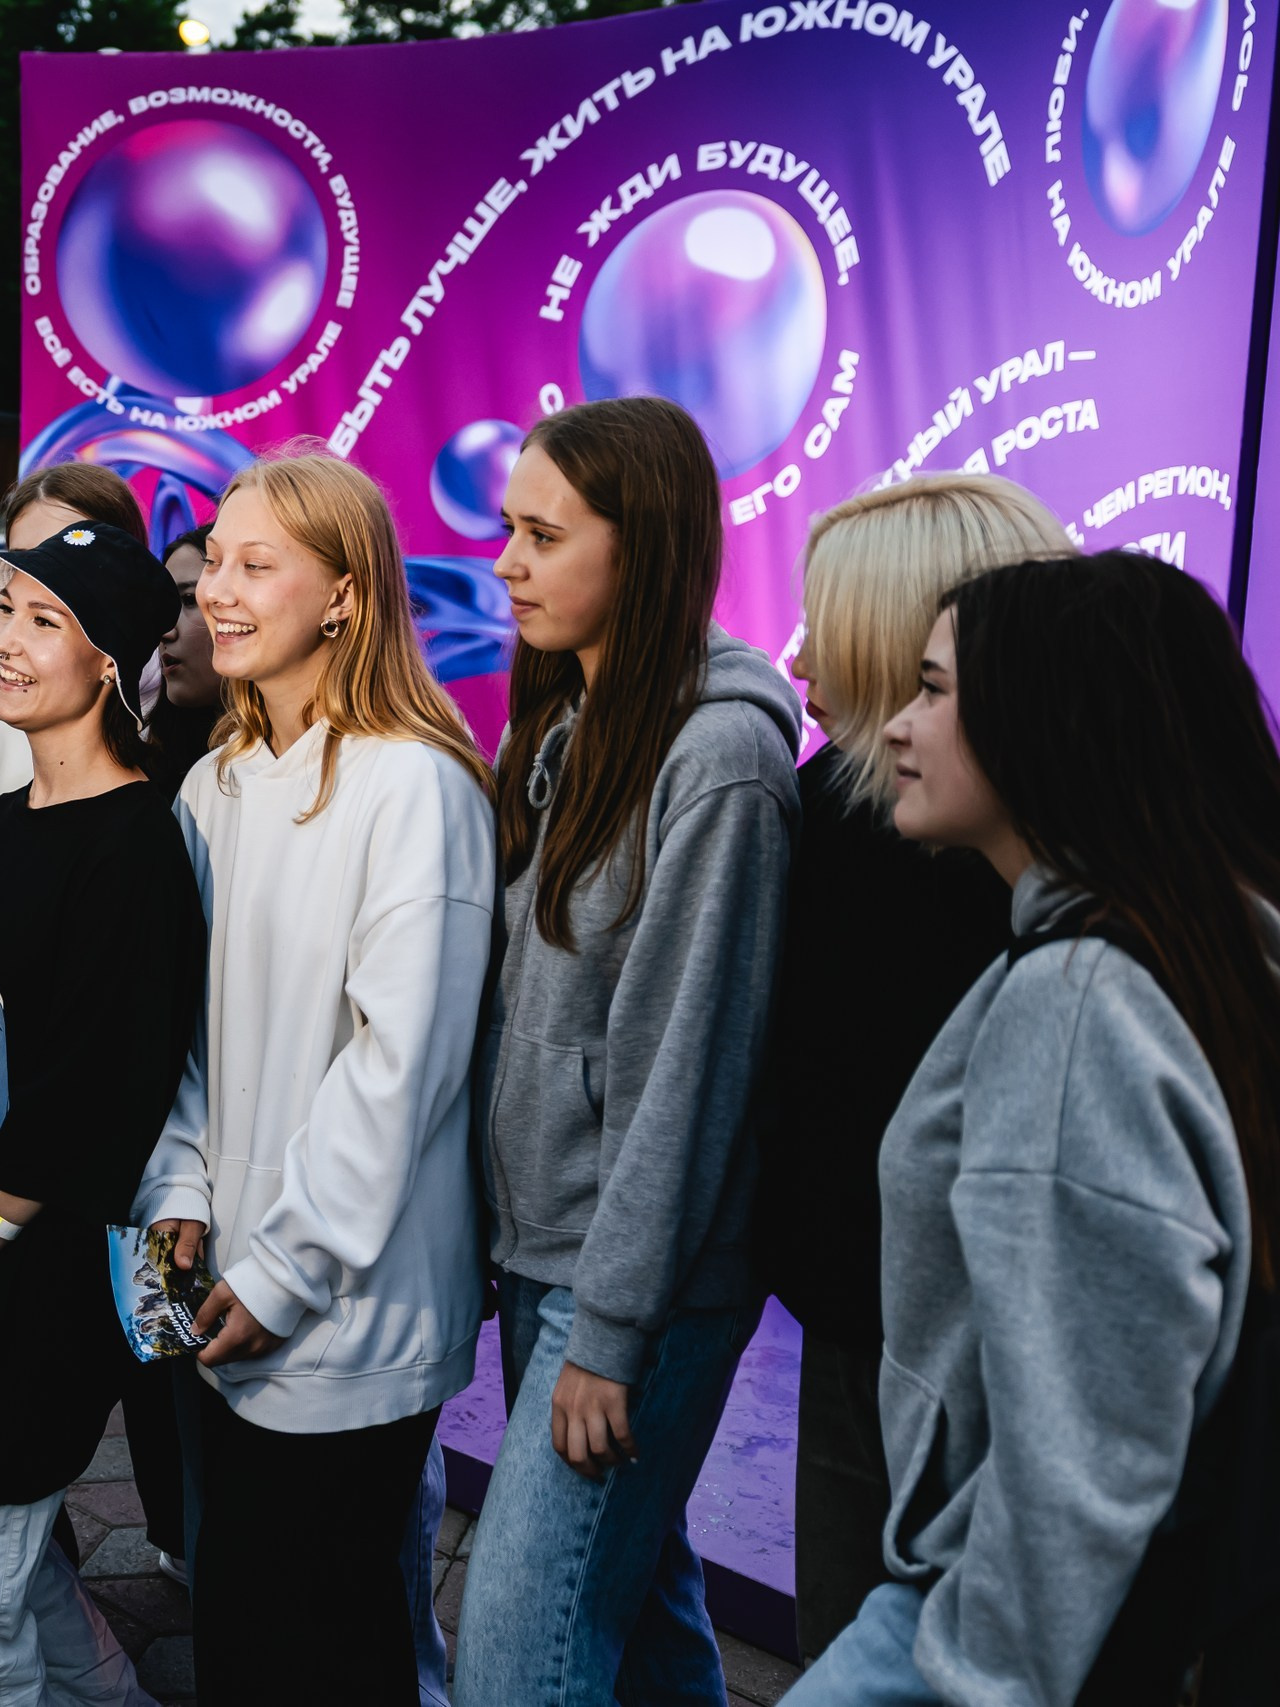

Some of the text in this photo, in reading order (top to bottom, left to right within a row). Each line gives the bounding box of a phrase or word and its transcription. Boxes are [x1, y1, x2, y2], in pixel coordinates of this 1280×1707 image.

[1045, 8, 1090, 164] ЛЮБИ,
[24, 109, 125, 296] ОБРАЗОВАНИЕ,
[128, 86, 333, 173] ВОЗМОЖНОСТИ,
[326, 0, 1012, 459] БЫТЬ ЛУЧШЕ, ЖИТЬ НА ЮЖНОМ УРАЛЕ
[540, 139, 860, 322] НЕ ЖДИ БУДУЩЕЕ,
[1047, 135, 1237, 309] НА ЮЖНОМ УРАЛЕ
[34, 315, 343, 432] ВСЁ ЕСТЬ НА ЮЖНОМ УРАЛЕ
[729, 349, 860, 526] ЕГО САМ
[872, 386, 974, 492] НЫЙ
[991, 398, 1100, 467] РОСТА
[1083, 465, 1232, 529] ЧЕМ РЕГИОН,
